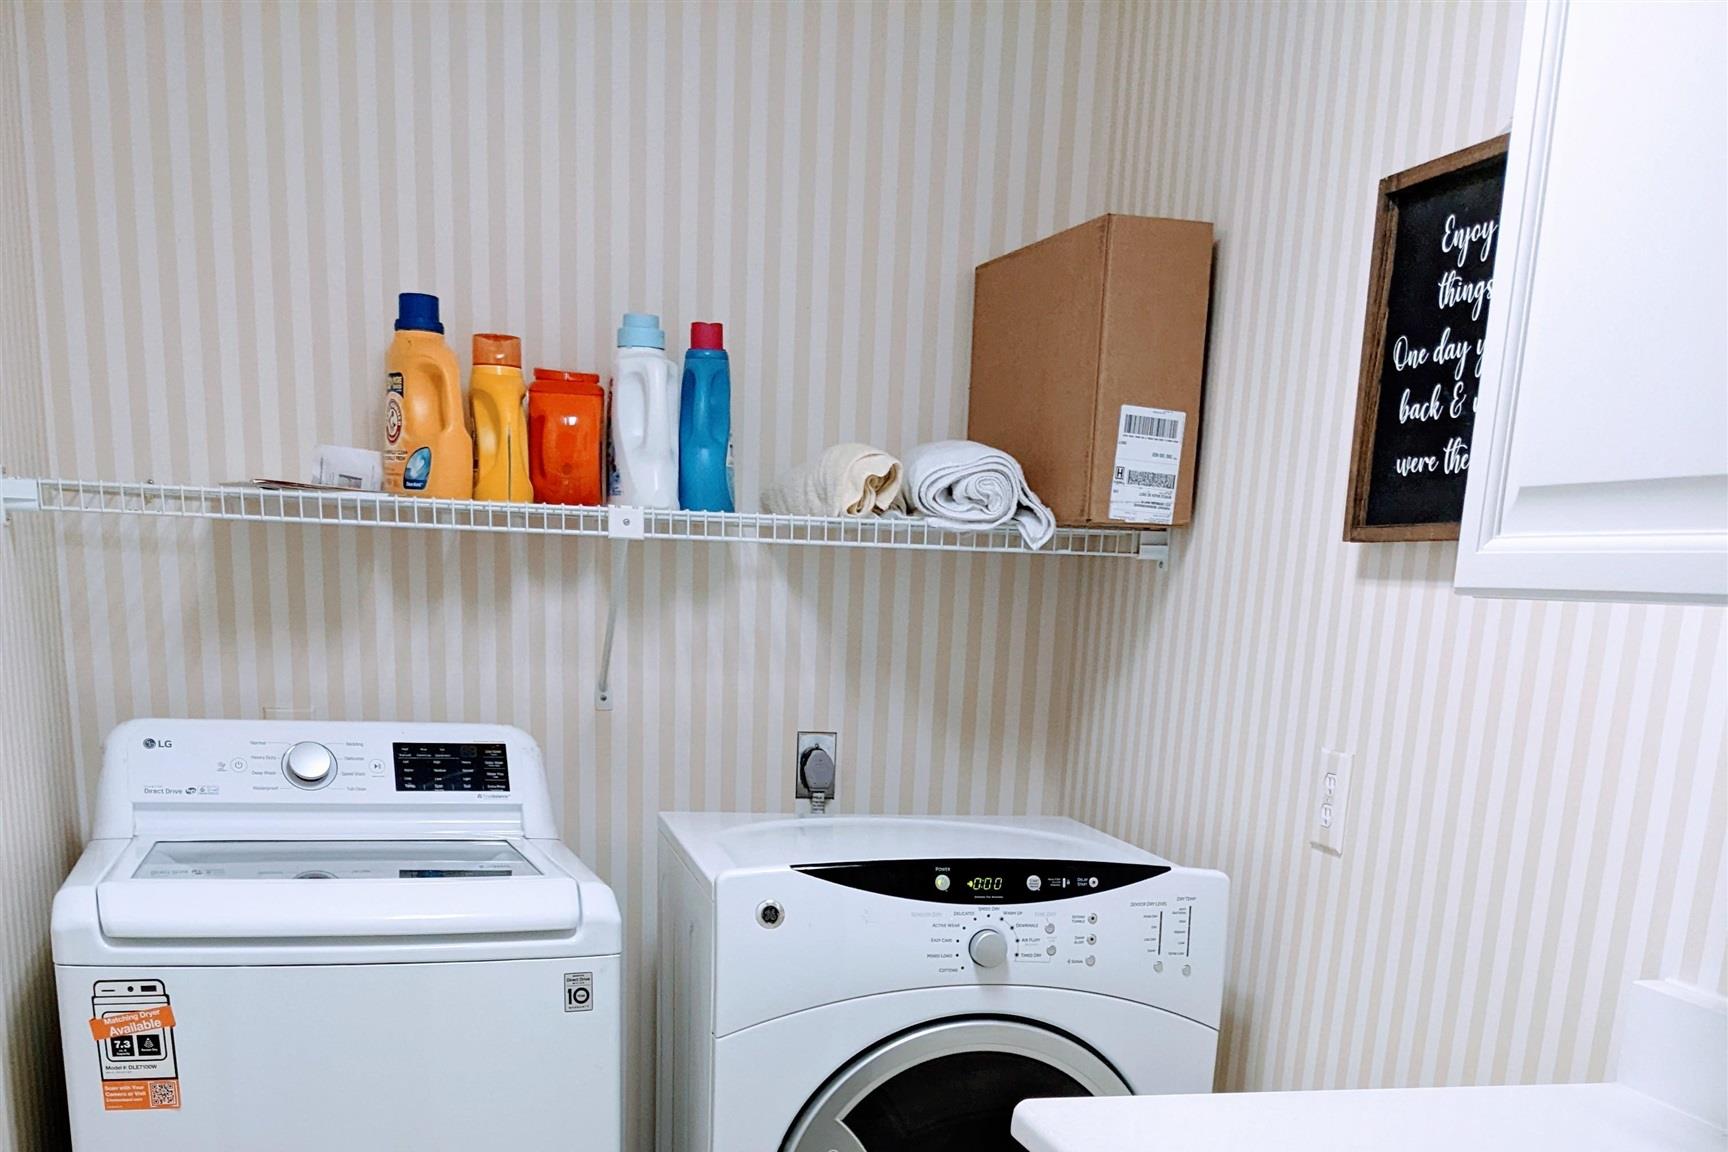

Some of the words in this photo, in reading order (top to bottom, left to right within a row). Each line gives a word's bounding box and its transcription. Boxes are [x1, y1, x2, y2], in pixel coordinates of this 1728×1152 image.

[1442, 214, 1498, 268] Enjoy
[1438, 270, 1495, 321] things
[1393, 335, 1430, 371] One
[1433, 327, 1472, 380] day
[1399, 384, 1444, 424] back
[1450, 381, 1467, 418] &
[1396, 456, 1440, 477] were
[1443, 437, 1470, 474] the
[158, 740, 173, 748] LG
[103, 1013, 139, 1025] Matching
[139, 1009, 161, 1019] Dryer
[109, 1018, 162, 1038] Available
[114, 1040, 131, 1049] 7.3
